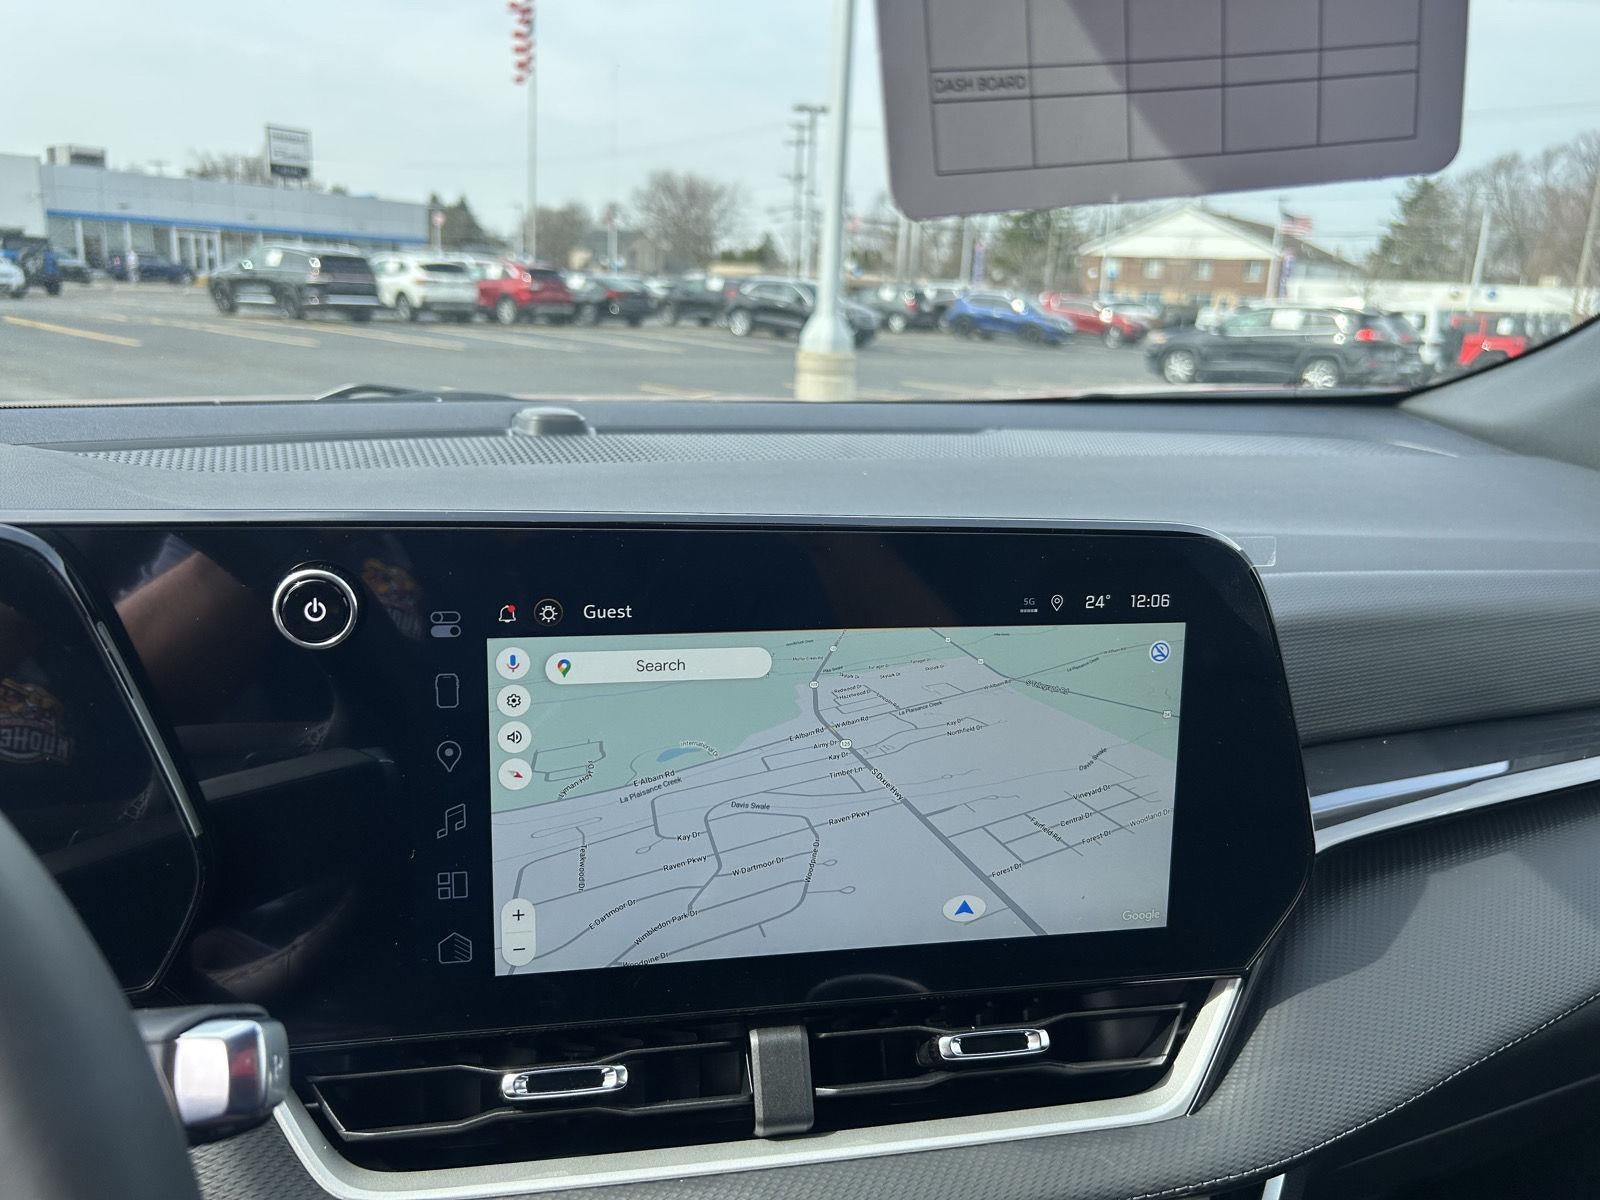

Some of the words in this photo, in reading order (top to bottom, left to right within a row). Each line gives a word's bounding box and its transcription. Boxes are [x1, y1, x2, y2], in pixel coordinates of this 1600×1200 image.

[934, 77, 974, 94] DASH
[978, 74, 1027, 92] BOARD
[1023, 597, 1036, 606] 5G
[1085, 594, 1111, 609] 24°
[1130, 594, 1170, 608] 12:06
[583, 604, 633, 619] Guest
[636, 658, 686, 673] Search
[841, 717, 860, 726] Albain
[860, 715, 869, 723] Rd
[795, 730, 815, 741] Albain
[815, 727, 824, 735] Rd
[946, 726, 975, 737] Northfield
[828, 752, 840, 761] Kay
[559, 781, 579, 798] Lyman
[587, 760, 595, 769] Dr
[633, 779, 639, 787] E
[639, 773, 663, 785] Albain
[664, 769, 675, 778] Rd
[829, 768, 853, 779] Timber
[853, 766, 863, 774] Ln
[619, 796, 629, 804] La
[629, 784, 662, 801] Plaisance
[663, 777, 682, 788] Creek
[876, 773, 891, 789] Dixie
[890, 785, 904, 801] Hwy
[1072, 786, 1102, 800] Vineyard
[730, 801, 750, 809] Davis
[750, 802, 771, 810] Swale
[828, 814, 850, 826] Raven
[850, 810, 870, 821] Pkwy
[1060, 814, 1085, 827] Central
[1129, 811, 1162, 828] Woodland
[1162, 808, 1171, 816] Dr
[676, 833, 691, 842] Kay
[691, 831, 701, 839] Dr
[1030, 816, 1053, 836] Fairfield
[1052, 831, 1062, 842] Rd
[1081, 832, 1103, 845] Forest
[578, 844, 588, 881] Teakwood
[663, 860, 686, 872] Raven
[687, 855, 707, 867] Pkwy
[731, 869, 740, 877] W
[741, 860, 775, 874] Dartmoor
[804, 848, 819, 883] Woodpine
[812, 839, 820, 848] Dr
[991, 865, 1013, 878] Forest
[1013, 863, 1022, 871] Dr
[578, 882, 586, 892] Dr
[588, 922, 595, 930] E
[595, 903, 627, 927] Dartmoor
[627, 899, 636, 907] Dr
[1122, 909, 1160, 922] Google
[634, 919, 671, 946] Wimbledon
[671, 912, 689, 924] Park
[689, 909, 698, 918] Dr
[659, 952, 669, 960] Dr
